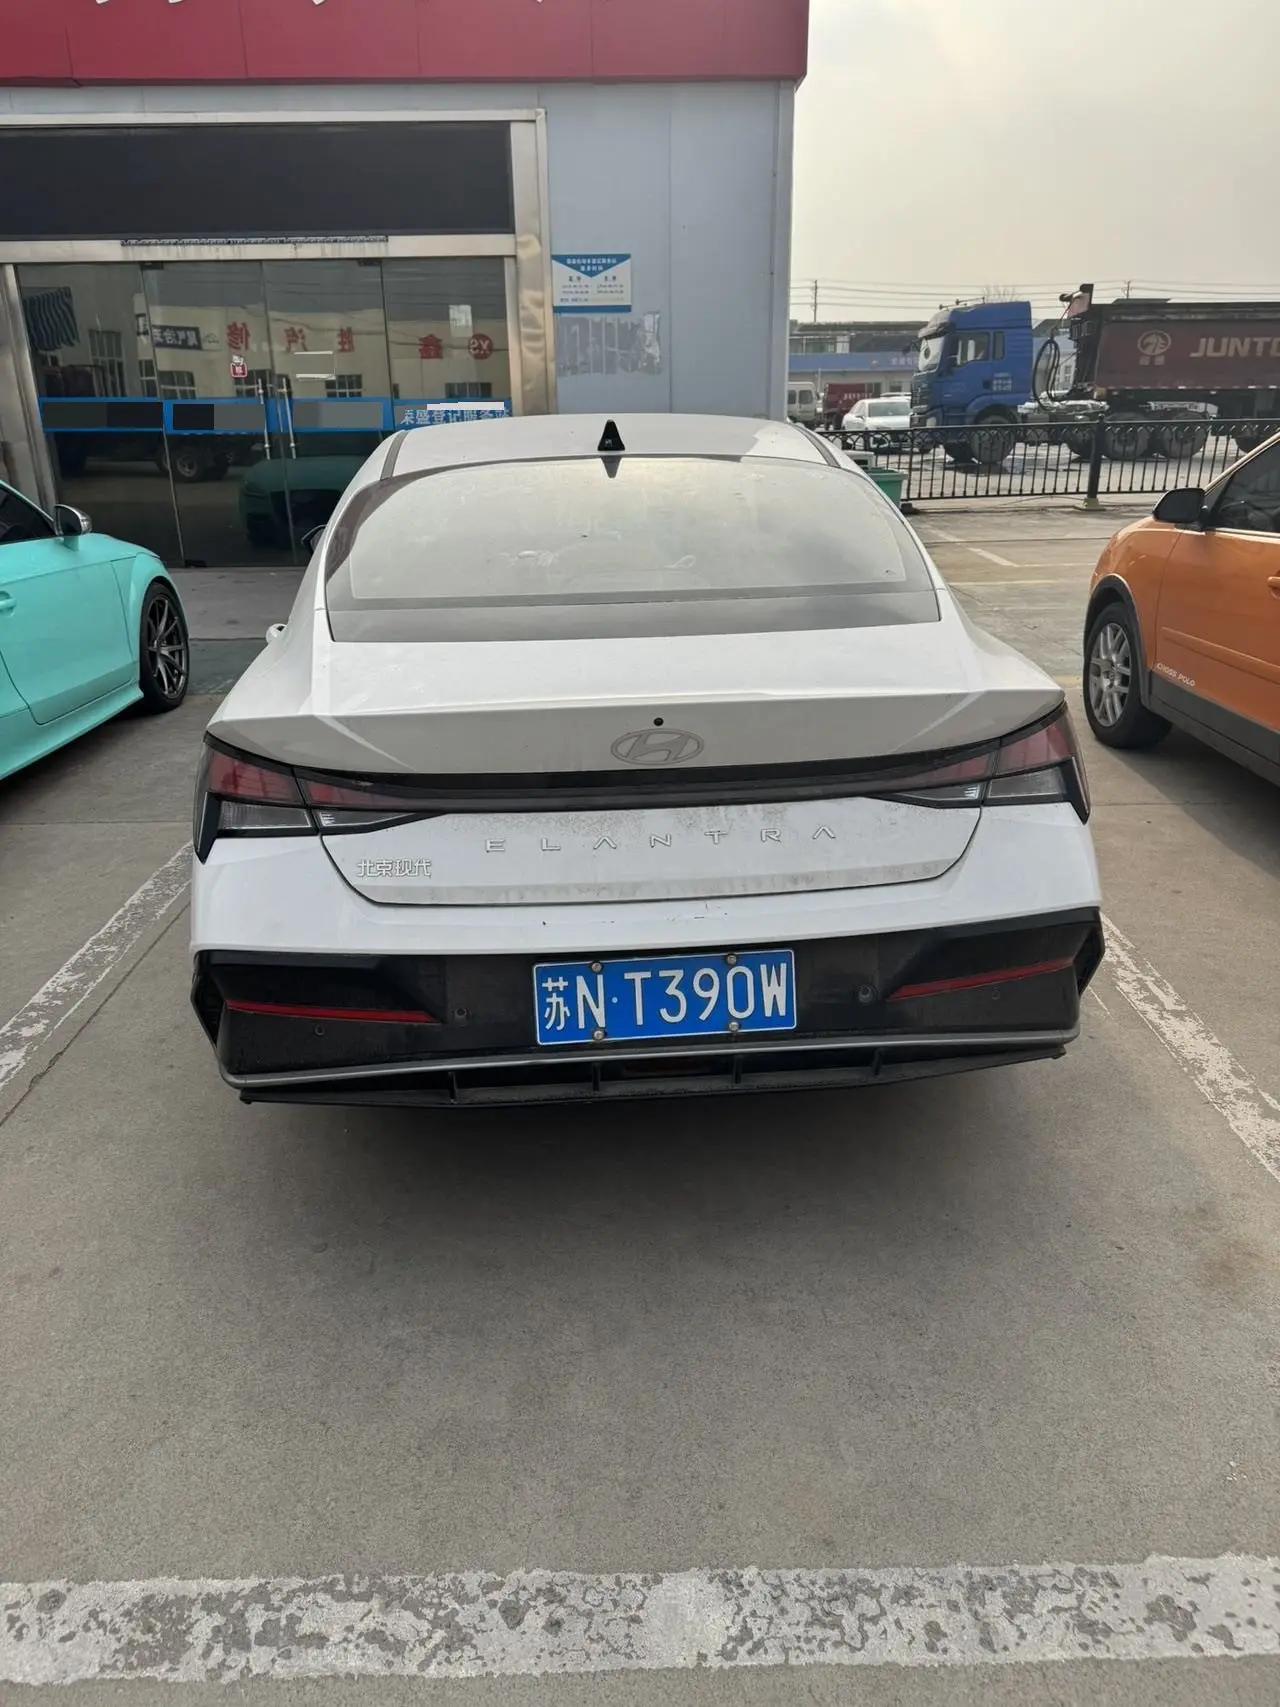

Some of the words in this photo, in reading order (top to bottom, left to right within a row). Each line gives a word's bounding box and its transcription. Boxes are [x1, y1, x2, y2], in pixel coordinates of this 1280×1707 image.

[484, 824, 836, 854] ELANTRA
[356, 858, 432, 878] 北京现代
